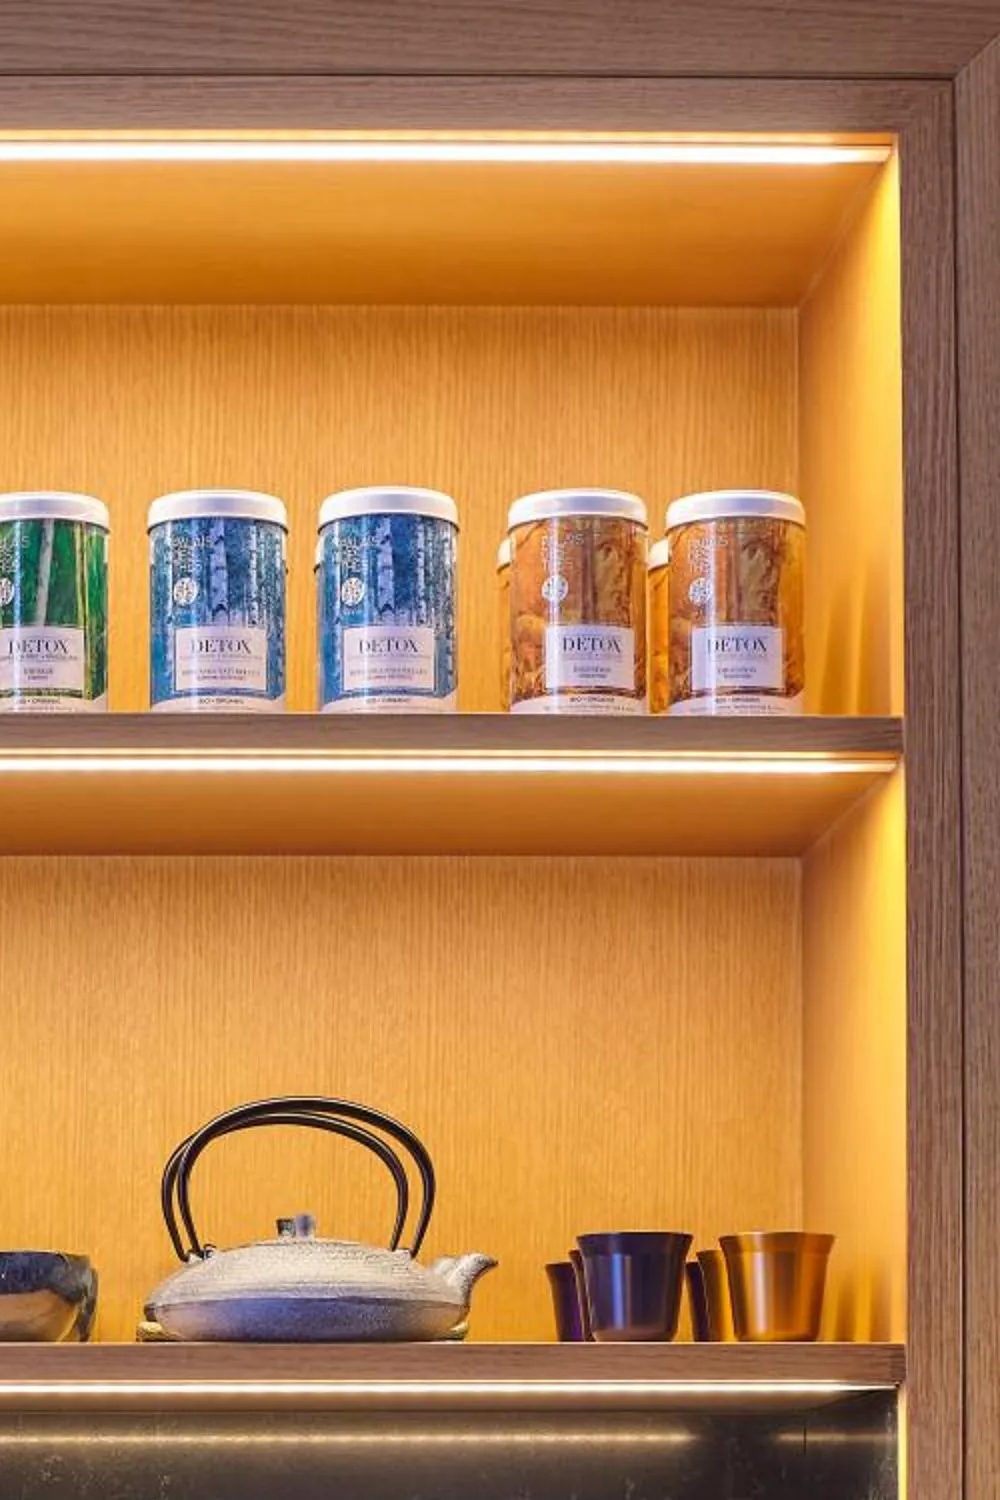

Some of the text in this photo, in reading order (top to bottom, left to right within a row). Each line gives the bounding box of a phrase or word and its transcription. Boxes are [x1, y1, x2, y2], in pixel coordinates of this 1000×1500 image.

[9, 640, 69, 654] DETOX
[191, 639, 252, 654] DETOX
[359, 639, 419, 653] DETOX
[563, 637, 622, 653] DETOX
[708, 638, 768, 652] DETOX
